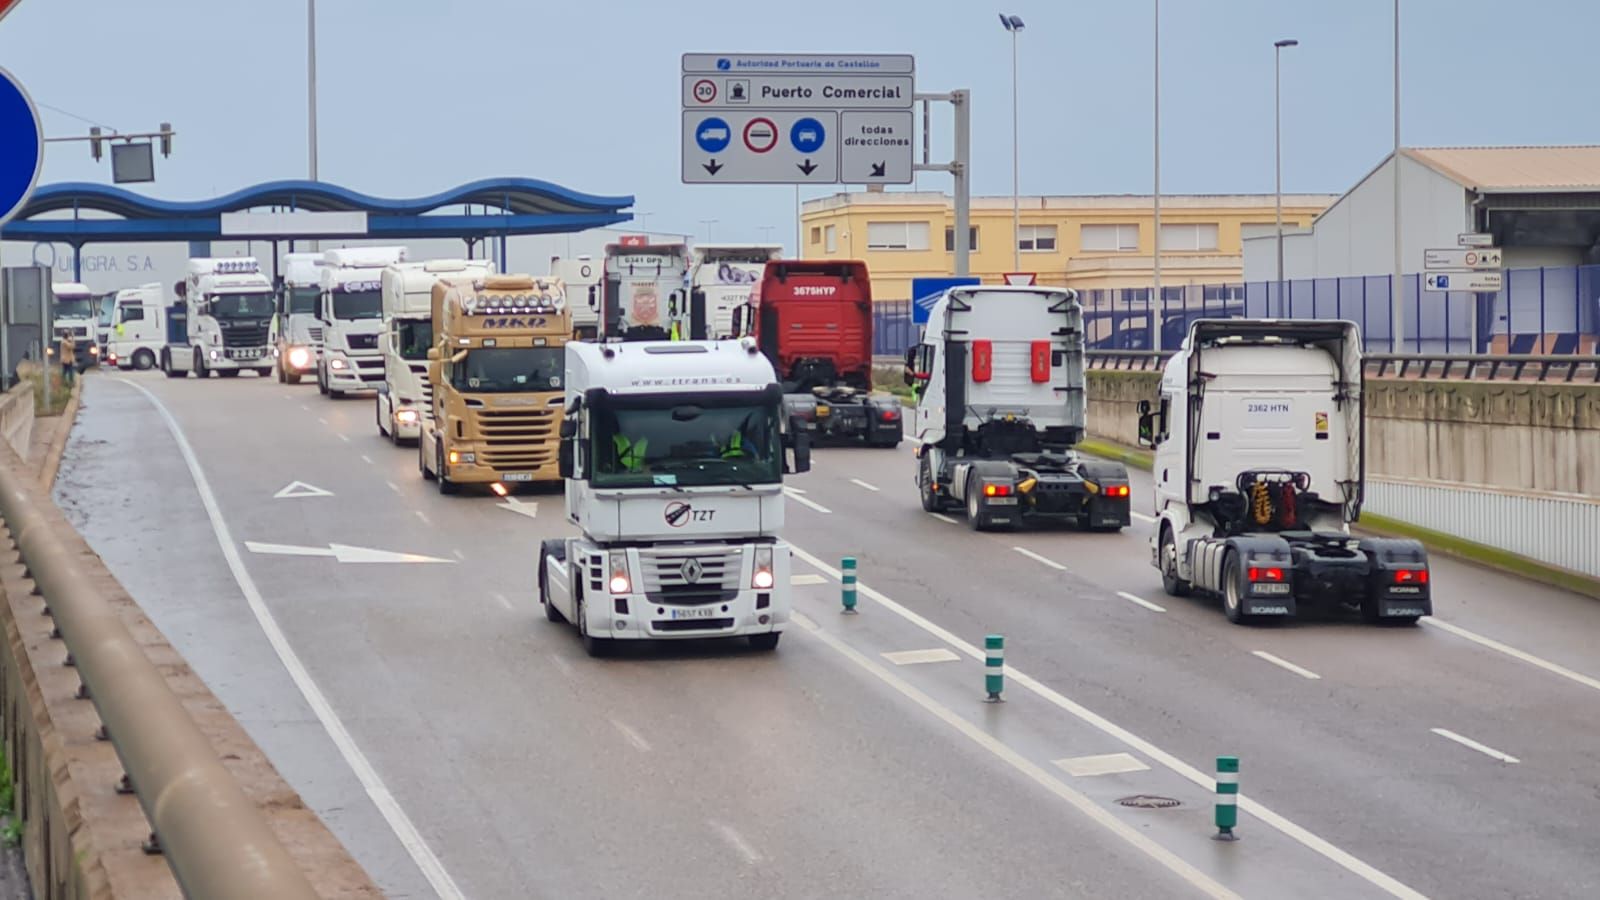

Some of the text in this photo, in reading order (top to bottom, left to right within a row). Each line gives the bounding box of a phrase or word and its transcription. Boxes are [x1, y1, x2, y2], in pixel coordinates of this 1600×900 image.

[698, 86, 712, 96] 30
[762, 86, 901, 99] Puerto Comercial
[861, 125, 894, 134] todas
[844, 136, 910, 146] direcciones
[631, 376, 742, 387] www.ttrans.es
[1247, 403, 1289, 413] 2362 HTN
[691, 509, 716, 521] TZT
